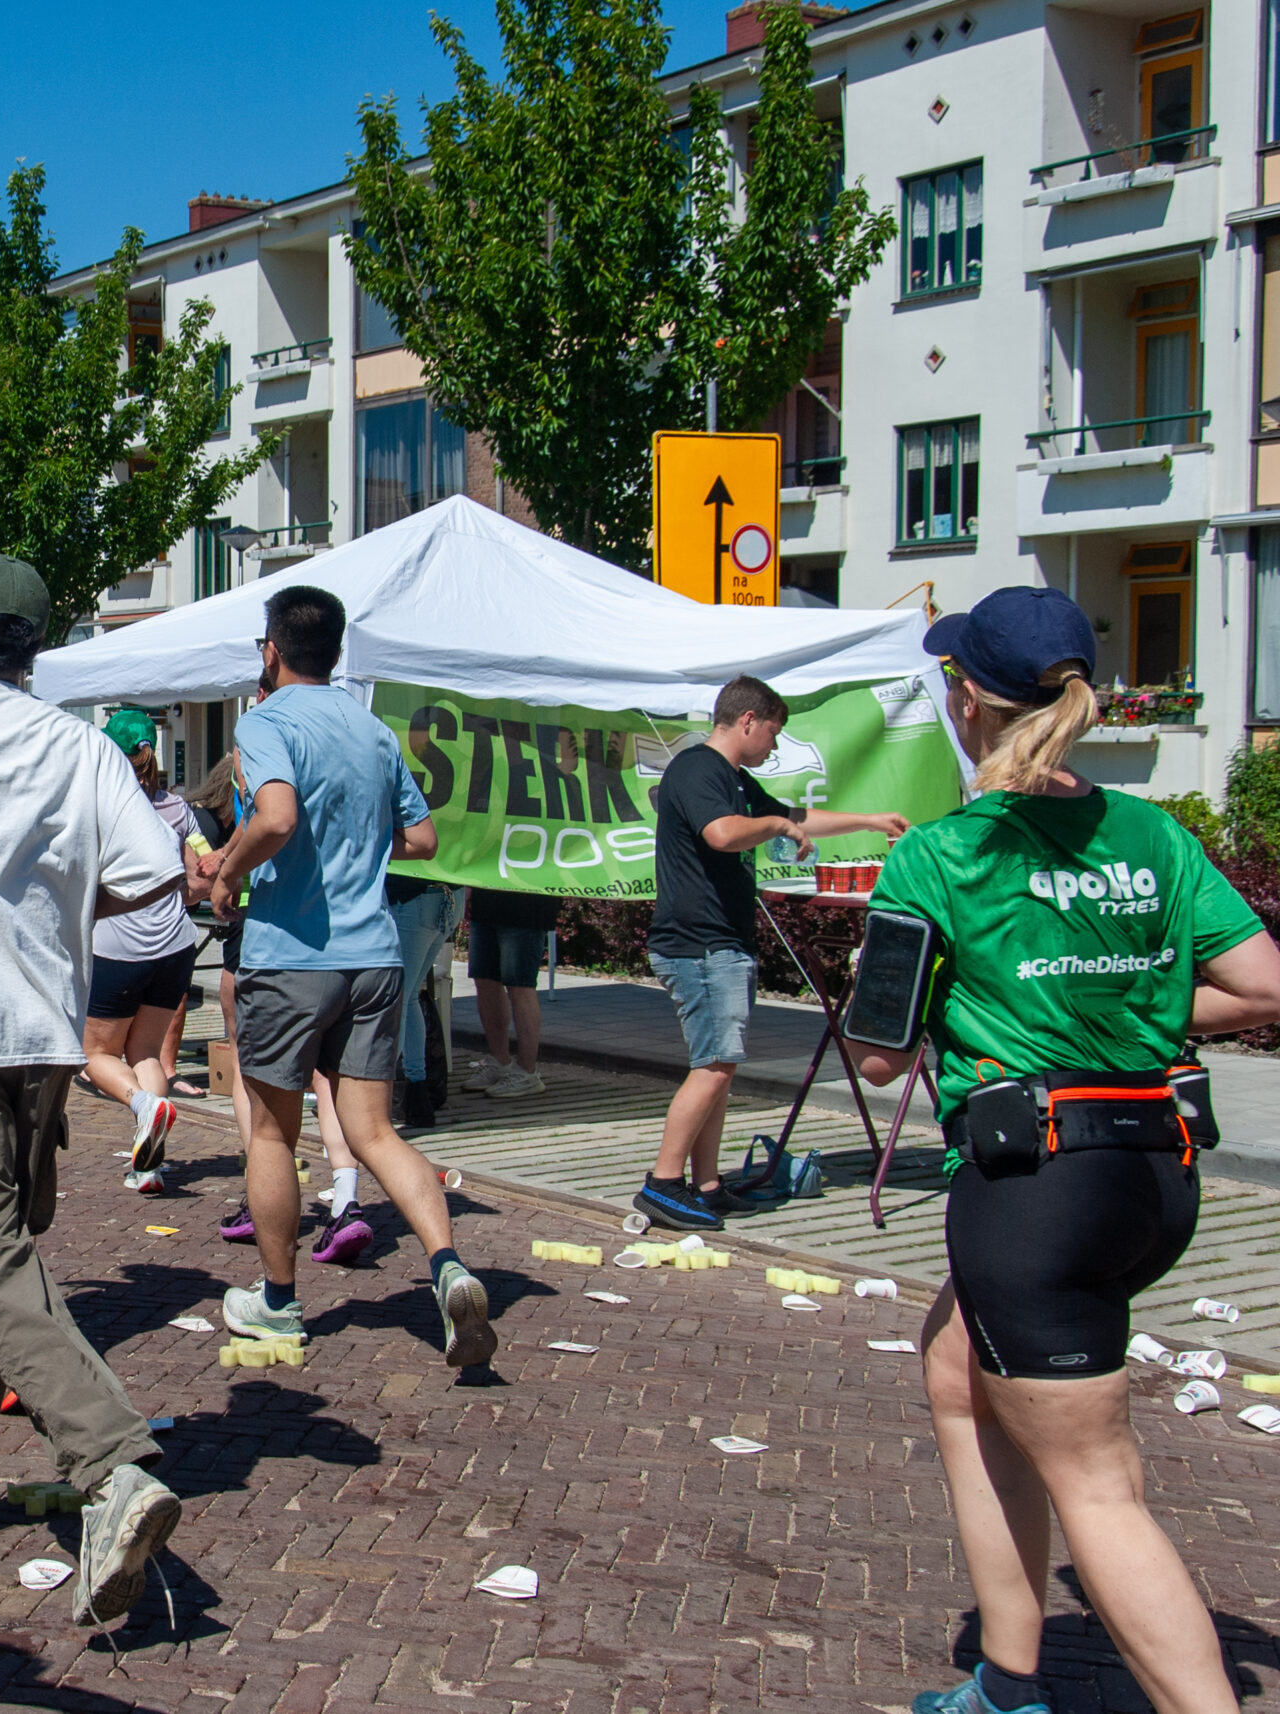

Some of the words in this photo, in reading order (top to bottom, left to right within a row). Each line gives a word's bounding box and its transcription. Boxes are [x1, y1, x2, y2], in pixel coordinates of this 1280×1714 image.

[732, 592, 765, 606] 100m
[733, 576, 748, 588] na
[407, 705, 645, 824] STERK
[498, 823, 657, 879] pos
[1028, 861, 1157, 911] apollo
[1097, 896, 1160, 916] TYRES
